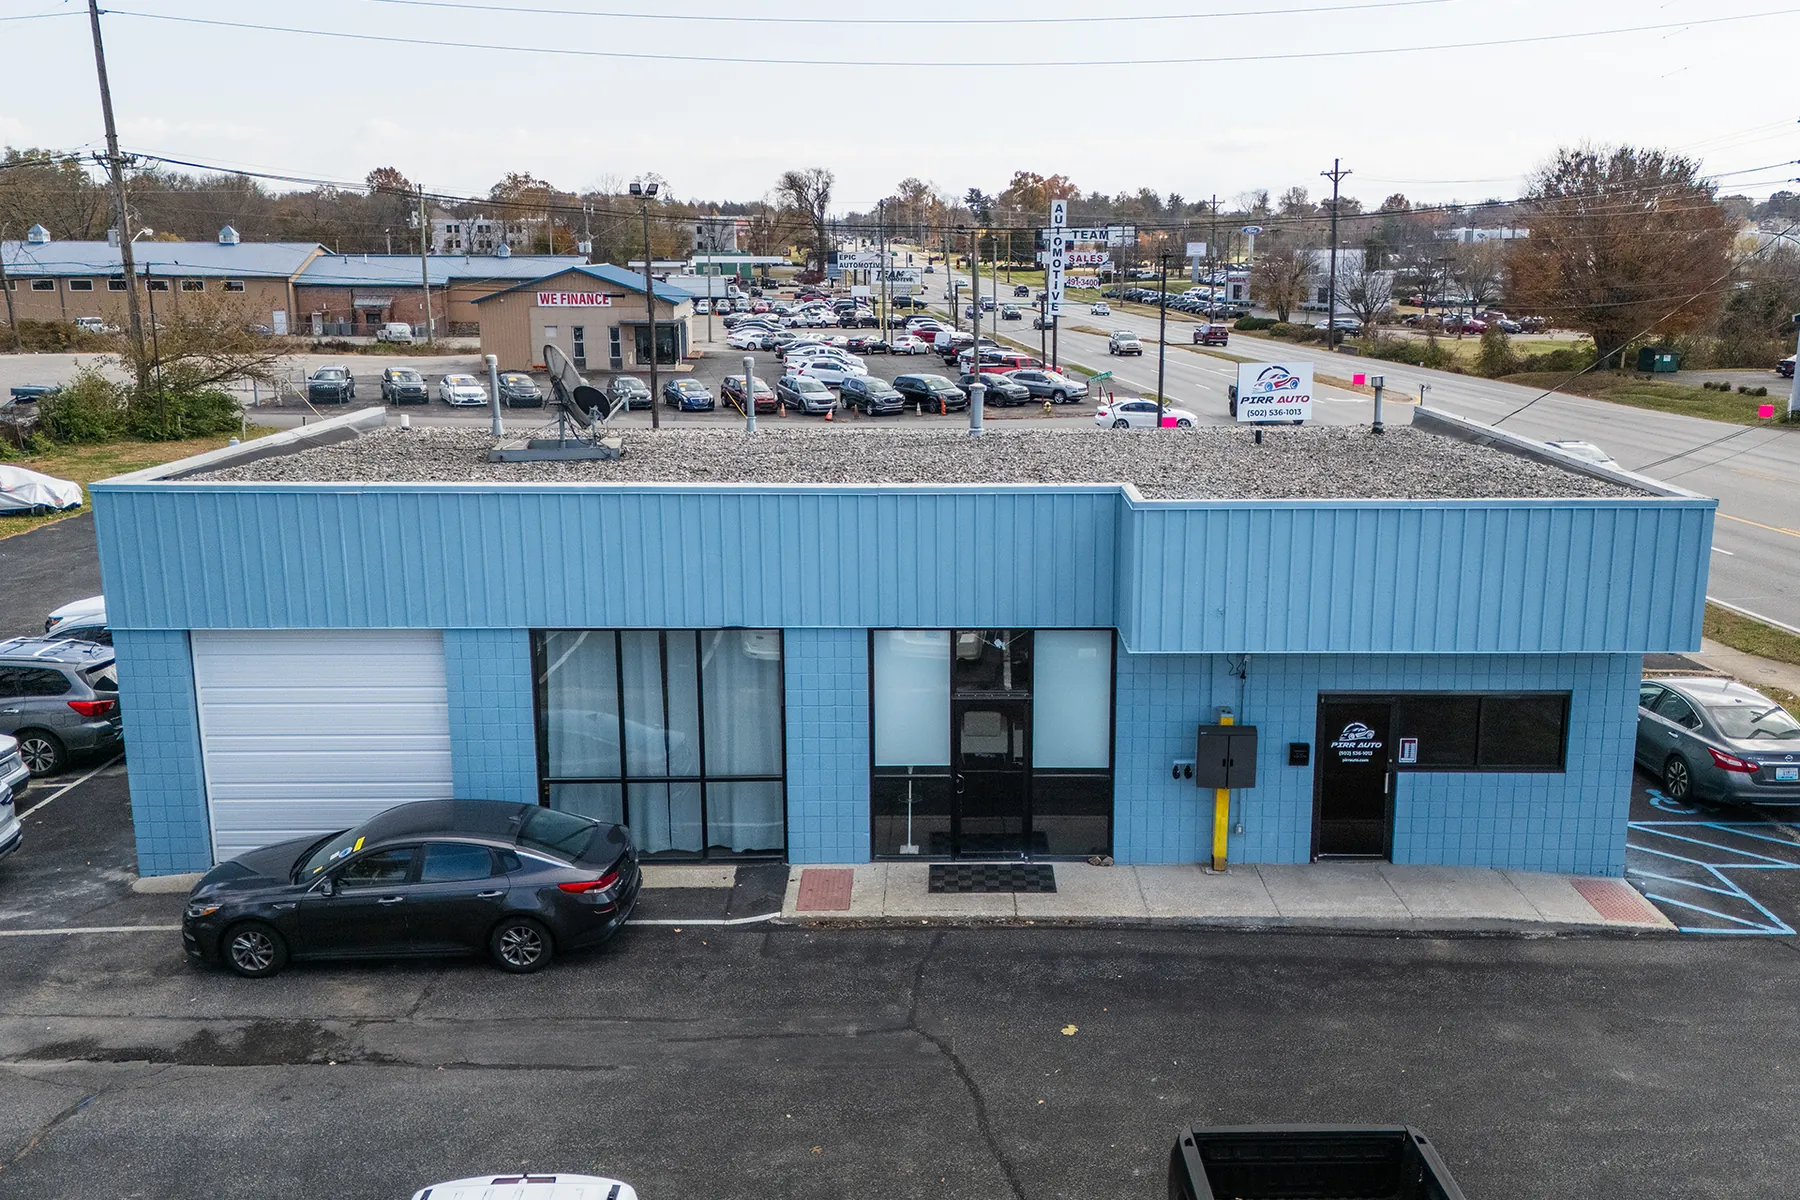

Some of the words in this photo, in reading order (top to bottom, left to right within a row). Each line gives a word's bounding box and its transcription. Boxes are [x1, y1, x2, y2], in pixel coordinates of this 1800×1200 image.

[1072, 230, 1109, 240] TEAM
[1051, 204, 1064, 311] AUTOMOTIVE
[1069, 255, 1103, 263] SALES
[1066, 279, 1098, 287] 491-3400
[540, 293, 557, 304] WE
[560, 293, 609, 304] FINANCE
[1240, 396, 1274, 404] PIRR
[1277, 395, 1310, 403] AUTO
[1247, 409, 1267, 417] (502)
